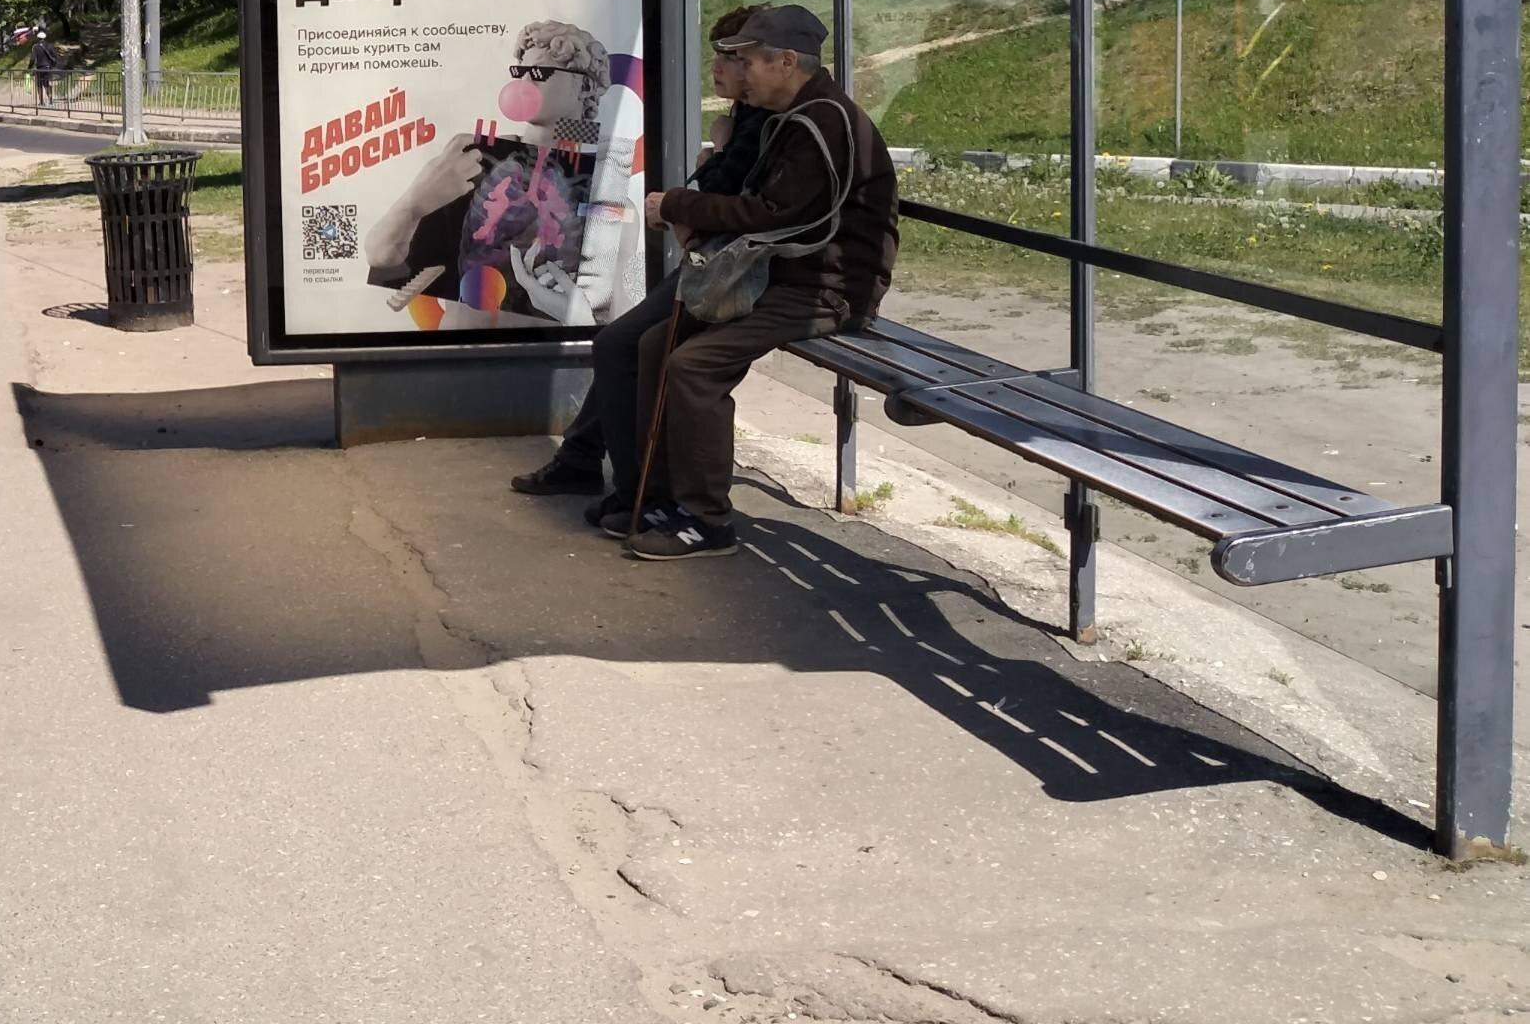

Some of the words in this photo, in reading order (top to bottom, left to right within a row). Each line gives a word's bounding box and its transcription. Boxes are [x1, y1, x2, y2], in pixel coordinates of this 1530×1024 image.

[297, 26, 407, 42] Присоединяйся
[411, 27, 419, 37] к
[422, 23, 509, 37] сообществу.
[298, 45, 360, 59] Бросишь
[363, 43, 410, 56] курить
[414, 41, 441, 52] сам
[298, 63, 306, 72] и
[310, 61, 360, 74] другим
[364, 58, 443, 70] поможешь.
[301, 86, 406, 164] ДАВАЙ
[301, 116, 436, 195] БРОСАТЬ
